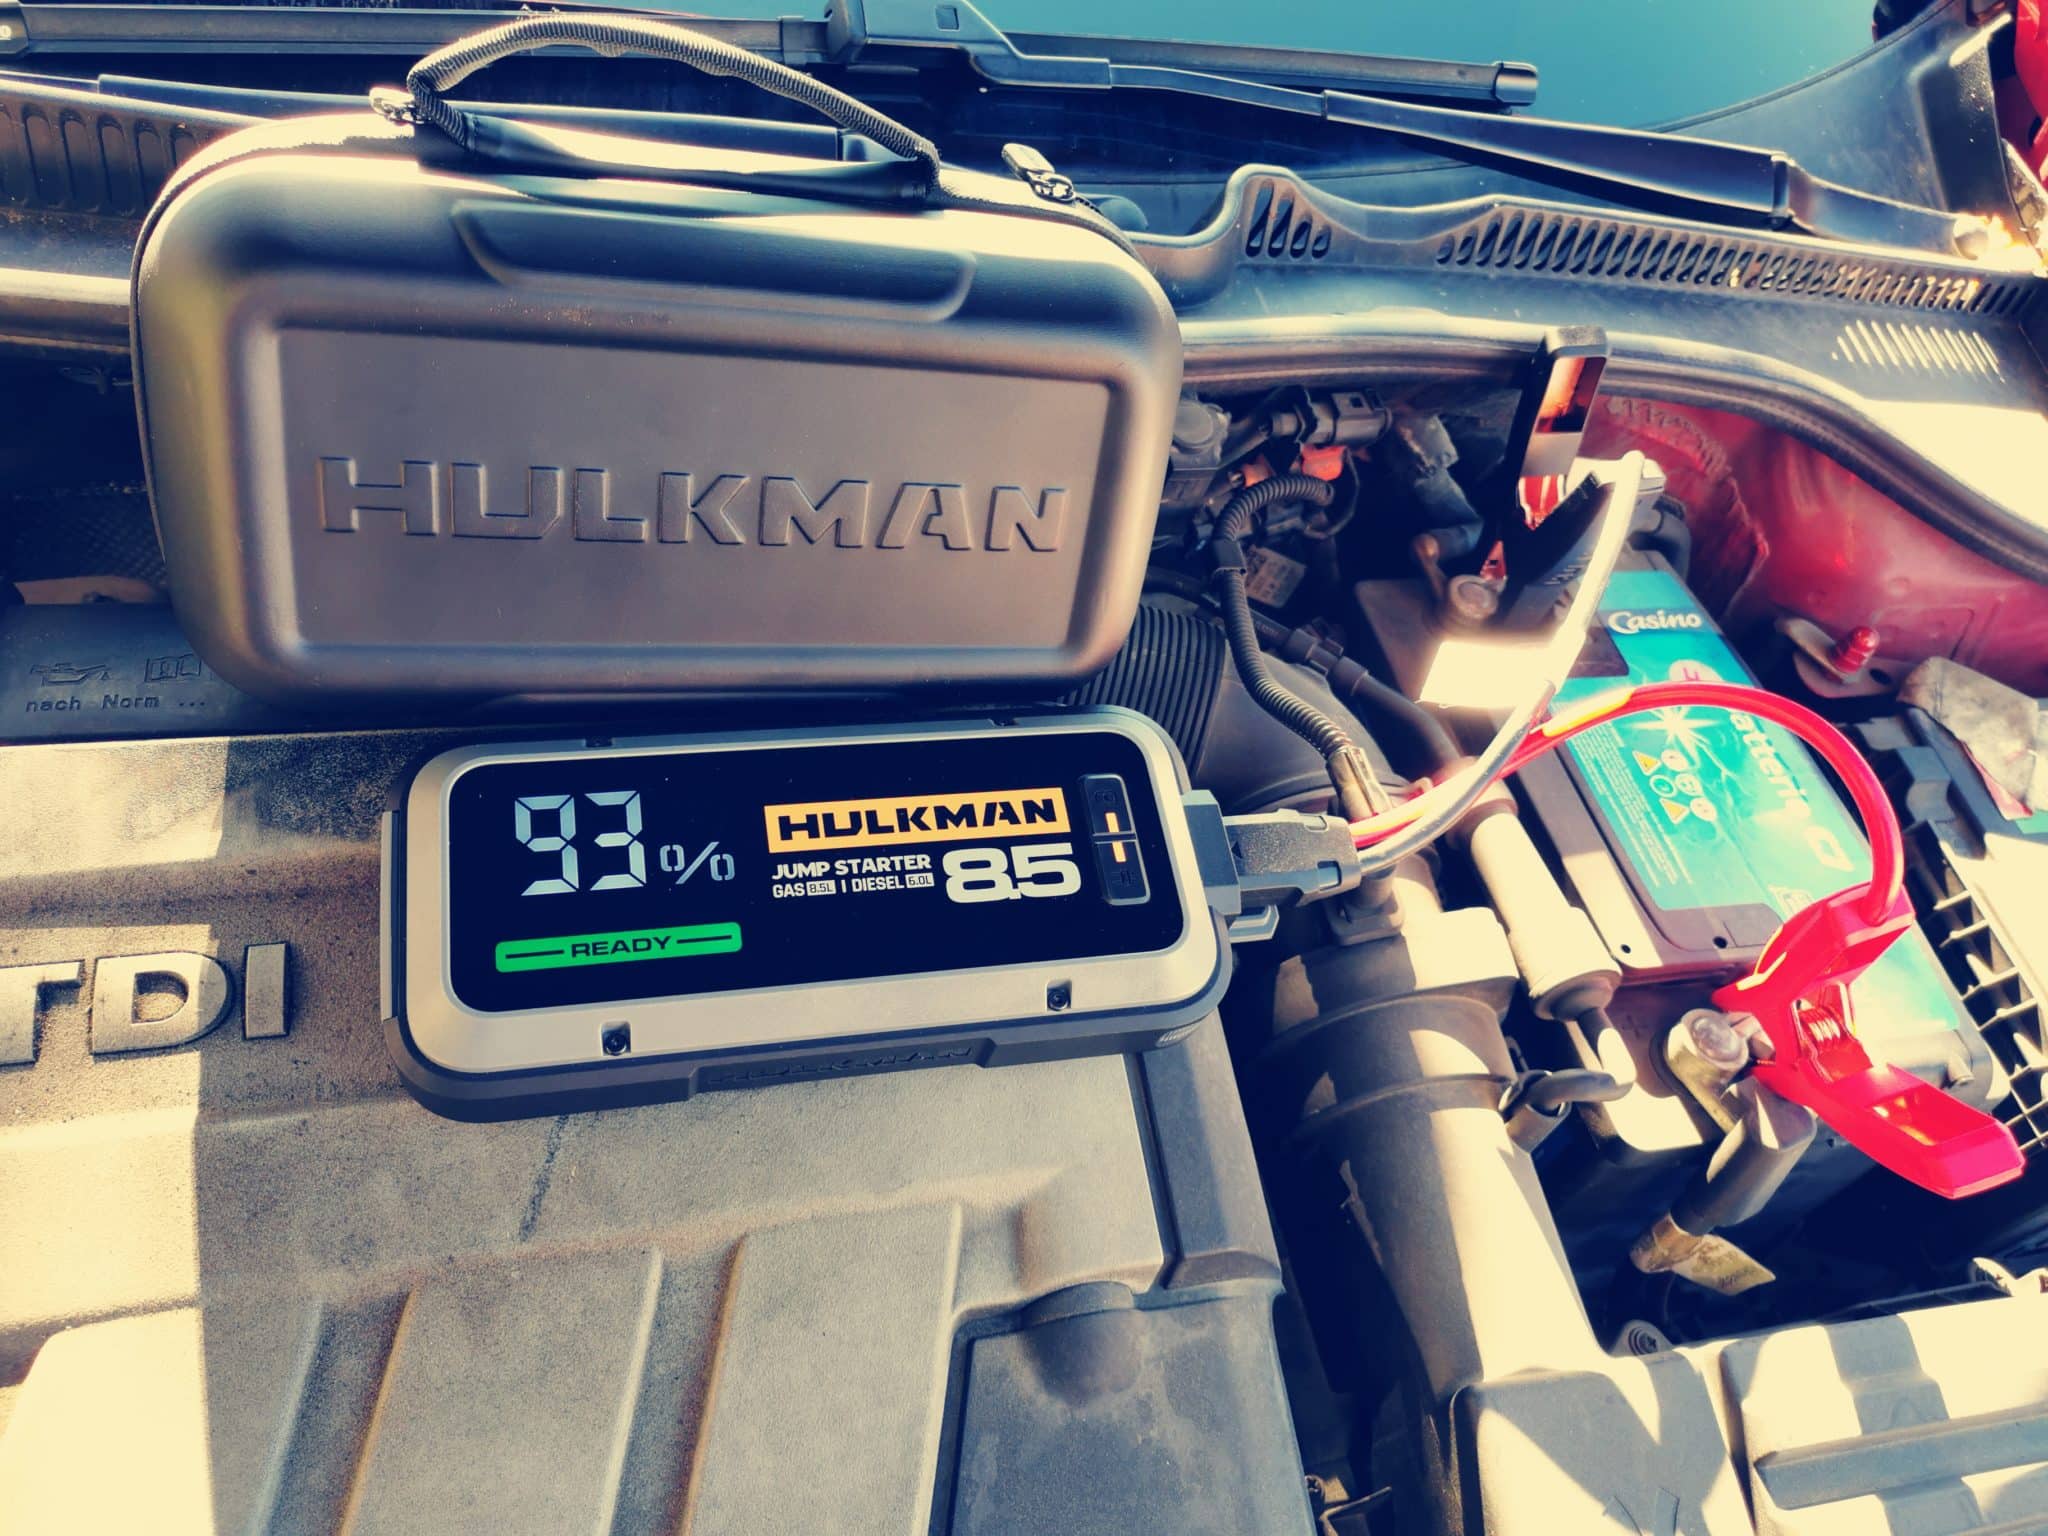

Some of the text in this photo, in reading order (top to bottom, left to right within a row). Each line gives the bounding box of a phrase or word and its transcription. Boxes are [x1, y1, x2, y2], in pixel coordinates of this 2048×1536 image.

[317, 456, 1069, 552] HULKMAN
[1608, 610, 1703, 635] Casino
[26, 696, 81, 713] nach
[102, 694, 160, 710] Norm
[777, 797, 1058, 842] HULKMAN
[771, 854, 932, 880] JUMP STARTER
[772, 883, 805, 899] GAS
[808, 881, 835, 895] 8.5L
[852, 876, 905, 893] DIESEL
[907, 874, 933, 887] 6.0L
[570, 935, 673, 959] READY
[0, 941, 289, 1069] TDI
